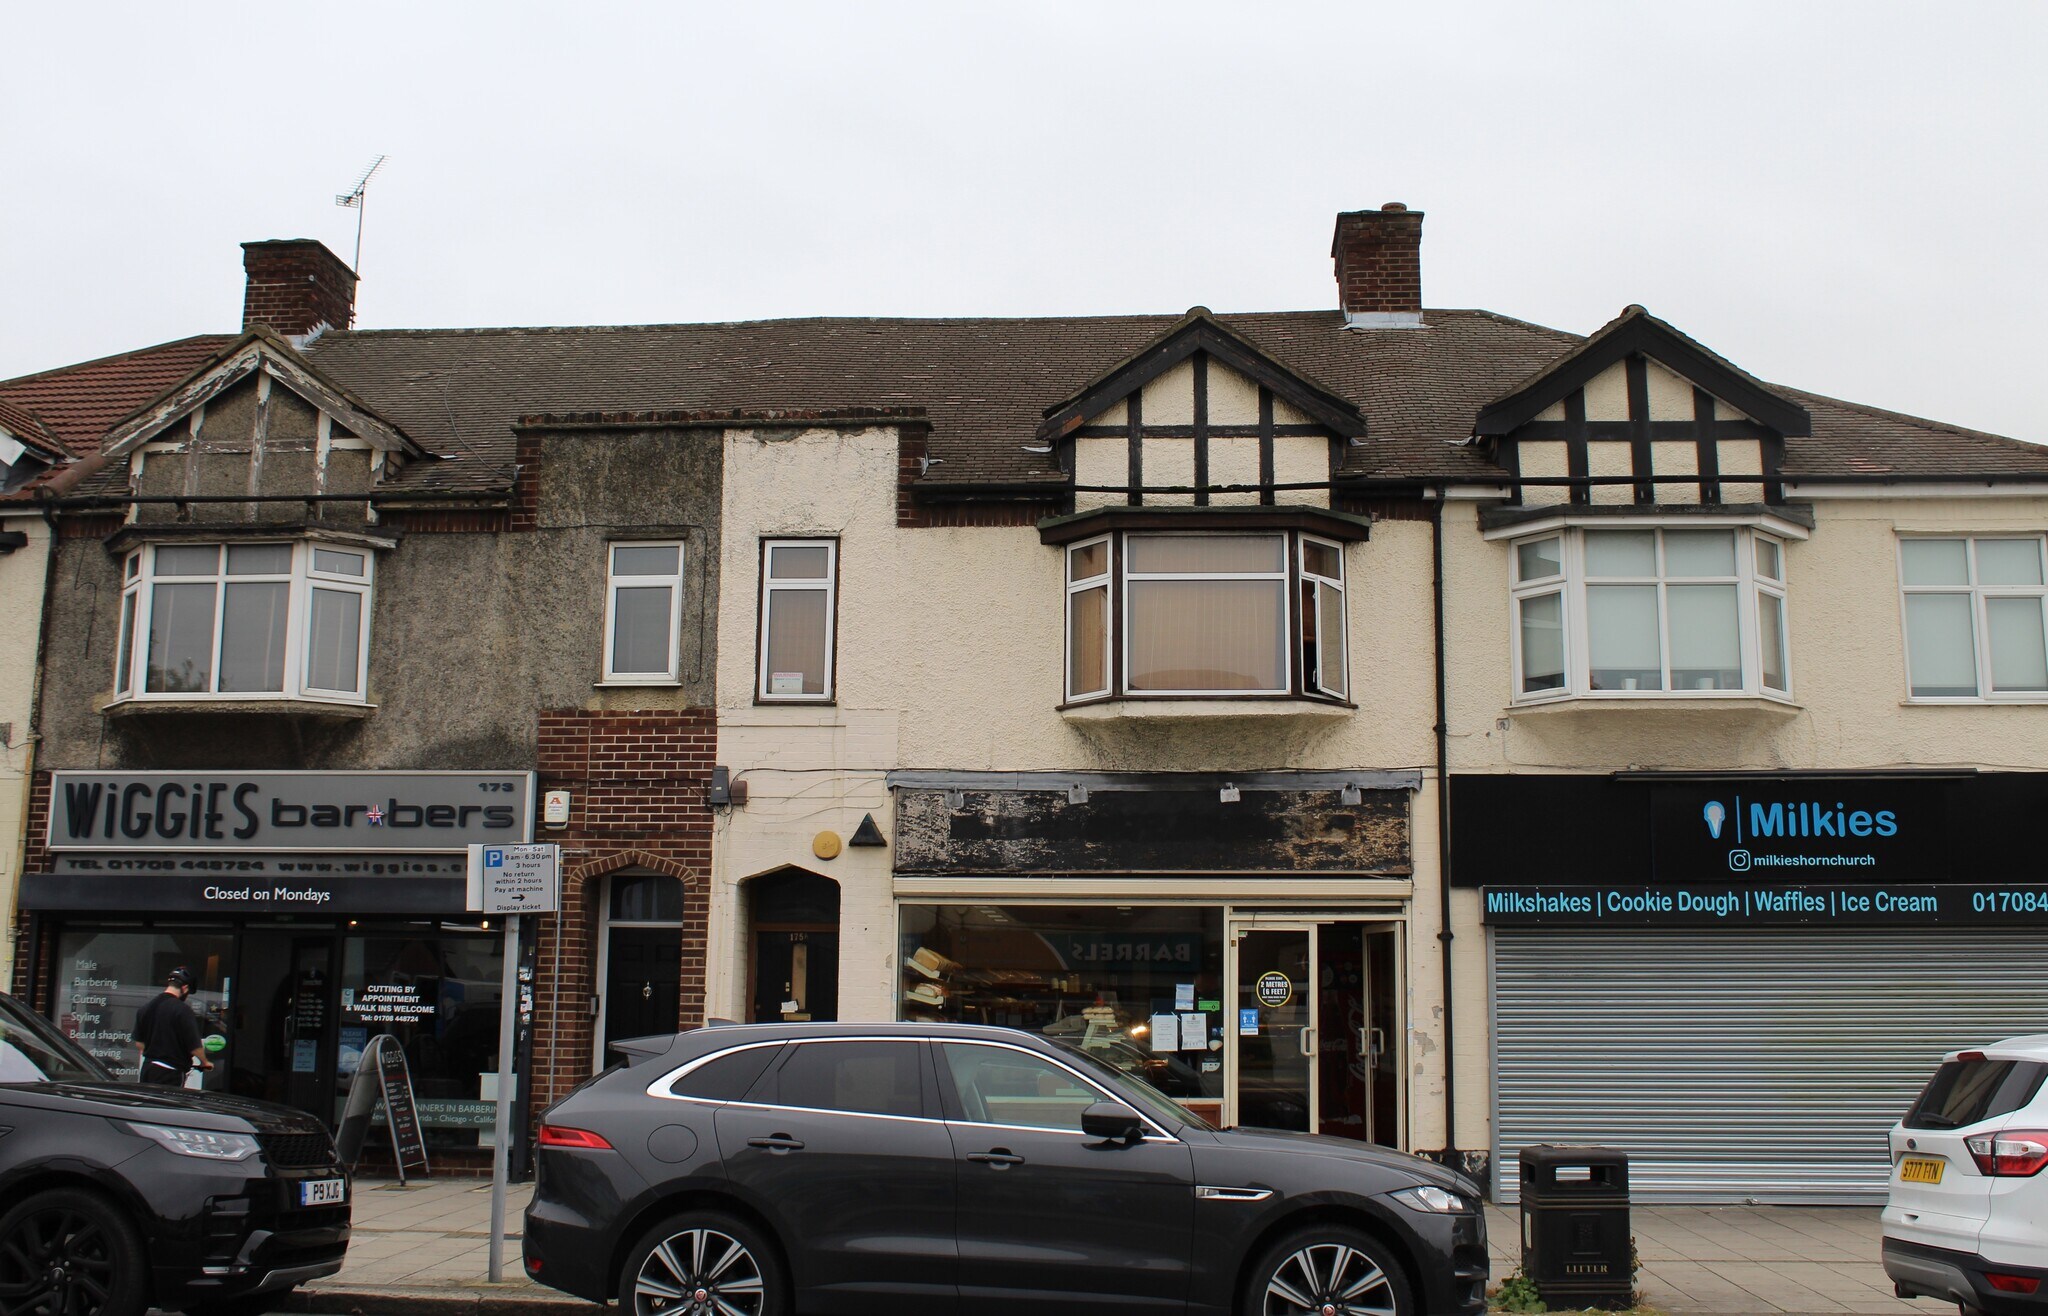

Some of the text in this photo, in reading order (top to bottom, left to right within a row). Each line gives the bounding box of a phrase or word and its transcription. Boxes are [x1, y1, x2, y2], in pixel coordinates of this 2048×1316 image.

[478, 782, 515, 792] 173
[1750, 802, 1898, 838] Milkies
[1754, 854, 1876, 866] milkieshornchurch
[66, 859, 467, 874] TEL 01708 448724 www.wiggies.c
[204, 886, 331, 904] Closed on Mondays
[1487, 891, 1592, 913] Milkshakes
[1607, 891, 1672, 912] Cookie
[1677, 890, 1739, 917] Dough
[1754, 890, 1826, 912] Waffles
[1841, 891, 1870, 912] Ice
[1875, 890, 1938, 912] Cream
[76, 960, 97, 969] Male
[73, 977, 118, 989] Barbering
[367, 985, 403, 993] CUTTING
[72, 994, 107, 1006] Cutting
[361, 994, 420, 1003] APPOINTMENT
[353, 1004, 376, 1012] WALK
[393, 1005, 435, 1013] WELCOME
[71, 1012, 100, 1023] Styling
[69, 1030, 132, 1042] Beard shaping
[115, 1067, 139, 1075] tonin
[416, 1104, 497, 1113] NNERS IN BARBERIN
[439, 1115, 467, 1124] Chicago
[473, 1115, 497, 1123] Califor
[1903, 1161, 1923, 1178] S777
[1566, 1265, 1608, 1273] LITTER
